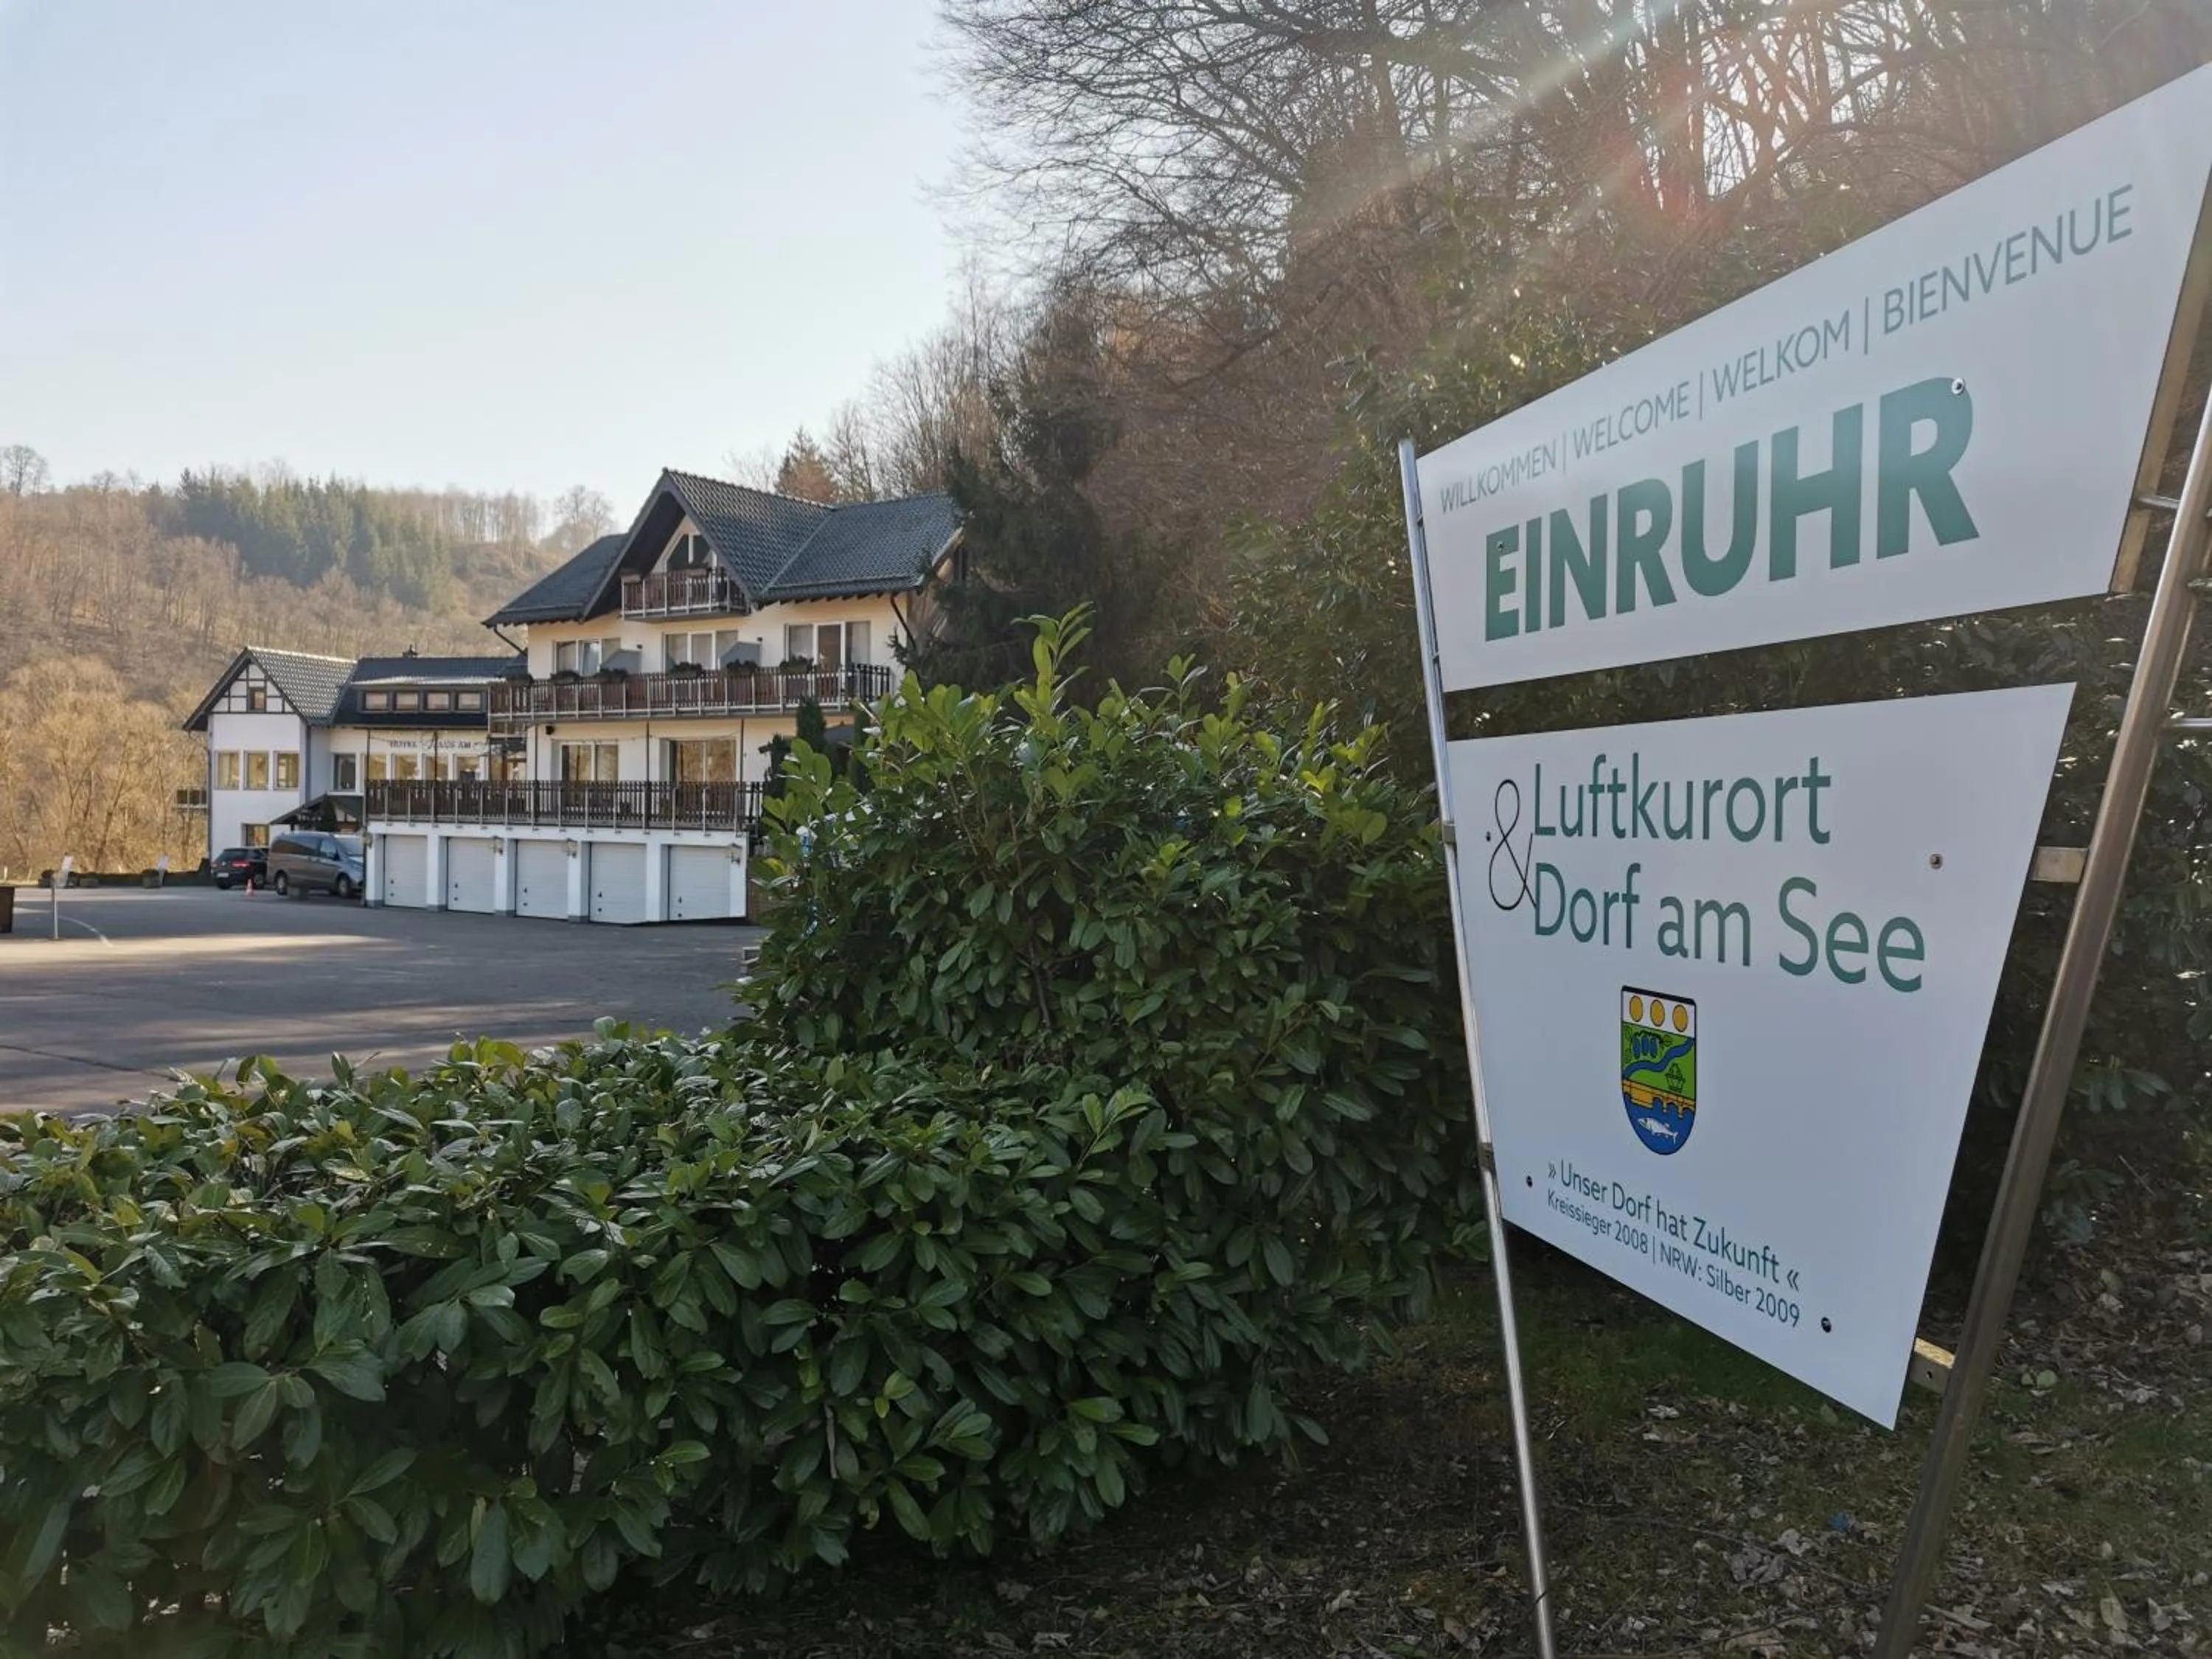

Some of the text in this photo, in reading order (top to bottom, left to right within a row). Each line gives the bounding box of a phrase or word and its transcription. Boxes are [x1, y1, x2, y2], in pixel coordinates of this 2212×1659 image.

[1440, 440, 1557, 513] WILLKOMMEN
[1573, 380, 1690, 459] WELCOME
[1711, 310, 1850, 403] WELKOM
[1883, 184, 2133, 335] BIENVENUE
[1484, 377, 1980, 642] EINRUHR
[1488, 778, 1537, 911] &
[1534, 752, 1832, 845] Luftkurort
[1534, 861, 1925, 993] Dorf am See
[1548, 1188, 1613, 1237] Kreissieger
[1614, 1219, 1649, 1255] 2008
[1659, 1241, 1703, 1282] NRW:
[1705, 1263, 1751, 1306] Silber
[1755, 1286, 1801, 1329] 2009
[1560, 1158, 1608, 1203] Unser
[1612, 1180, 1652, 1225] Dorf
[1656, 1197, 1688, 1242] hat
[1692, 1216, 1780, 1284] Zukunft
